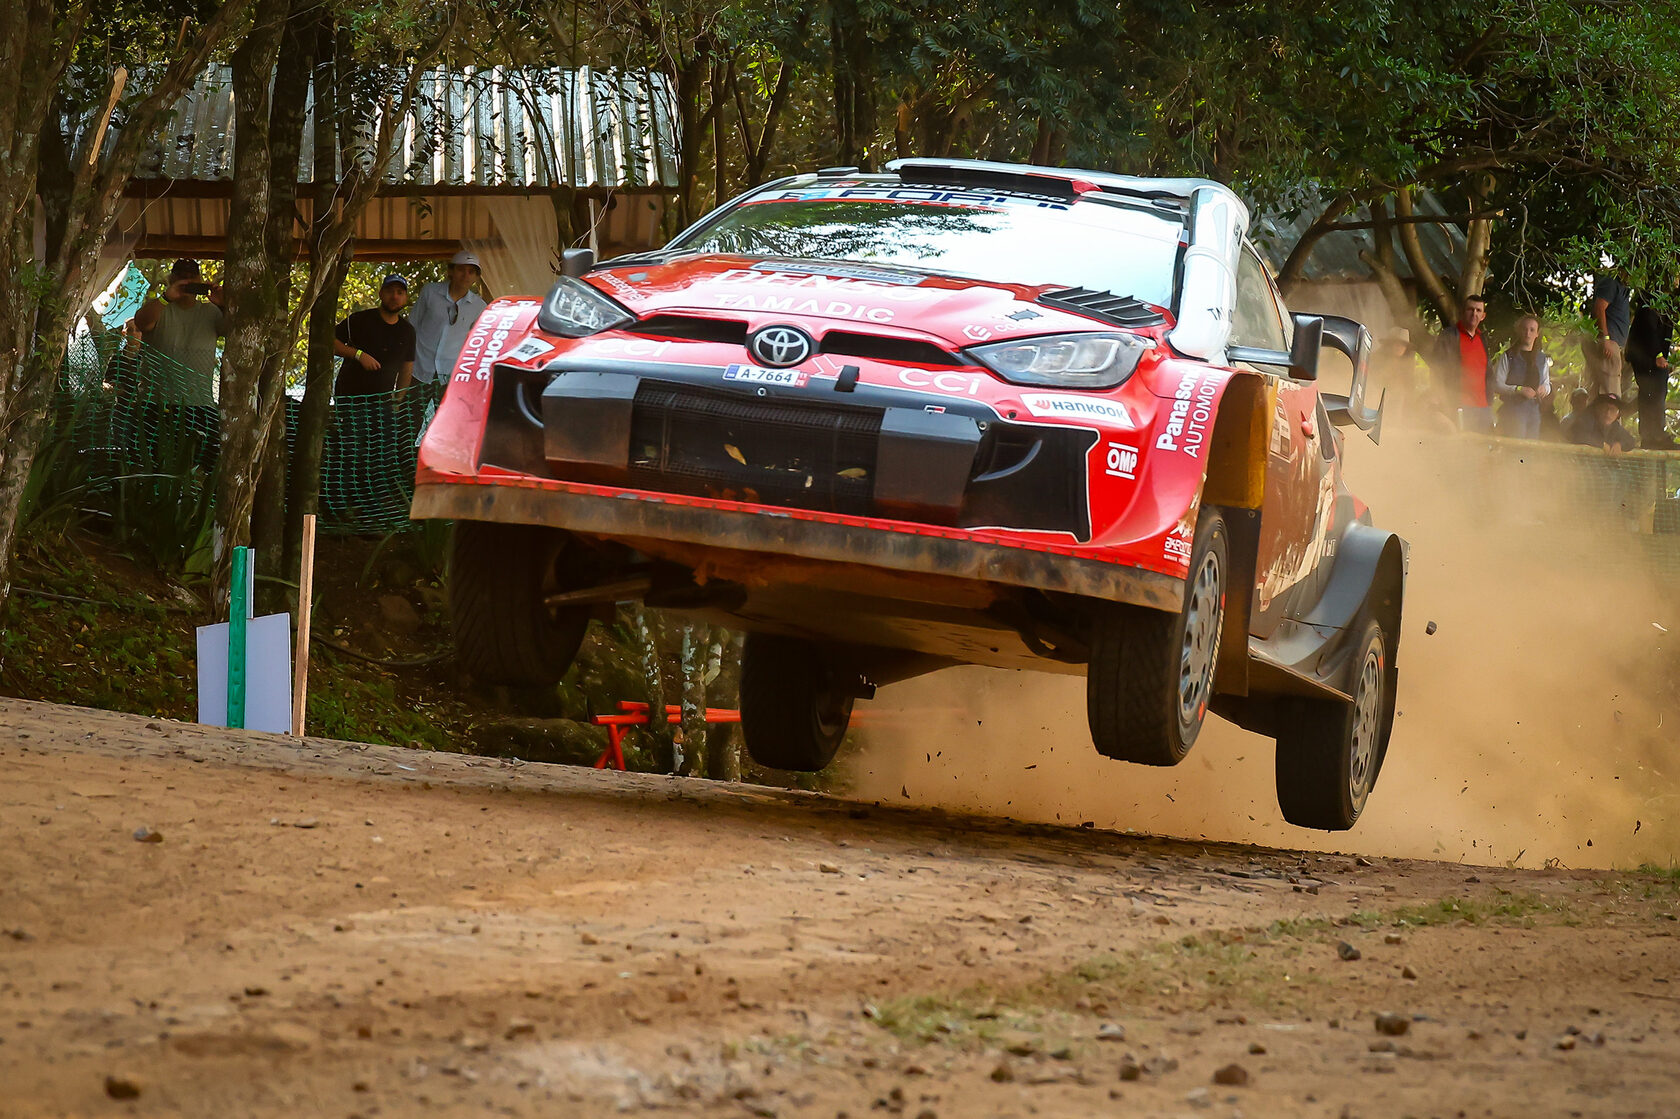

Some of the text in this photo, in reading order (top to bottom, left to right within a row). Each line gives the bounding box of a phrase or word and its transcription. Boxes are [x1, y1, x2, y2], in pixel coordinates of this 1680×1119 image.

[713, 293, 895, 323] TAMADIC
[741, 368, 793, 383] A-7664
[898, 368, 981, 395] CCI
[1107, 448, 1138, 474] OMP
